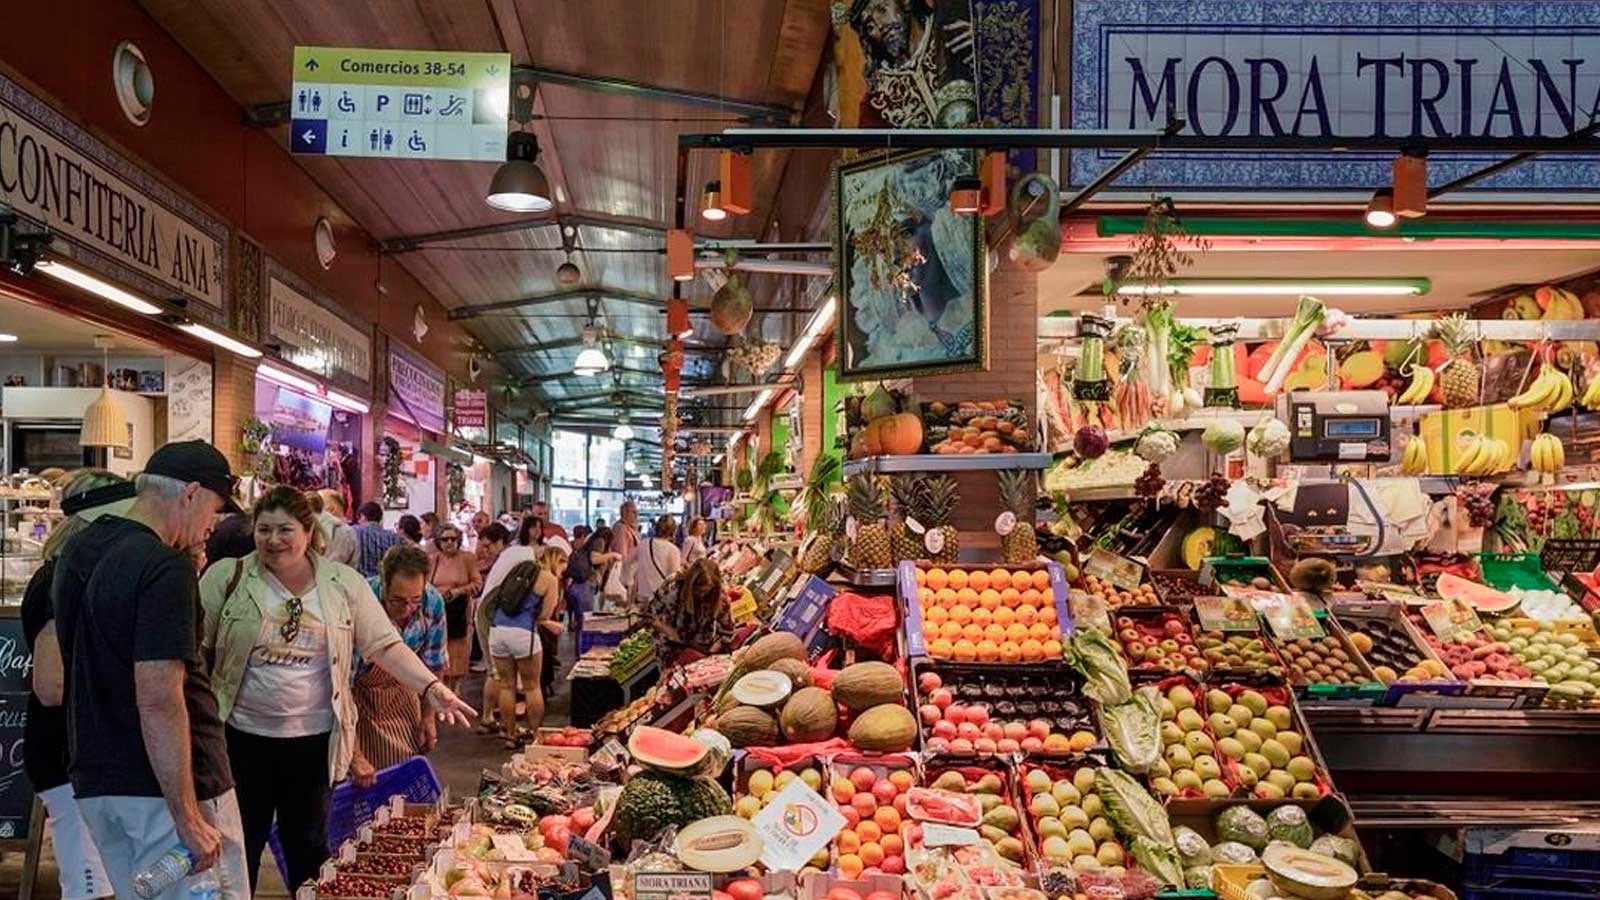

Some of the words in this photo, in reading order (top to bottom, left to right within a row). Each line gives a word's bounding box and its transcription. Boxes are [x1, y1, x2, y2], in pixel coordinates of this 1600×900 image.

[340, 58, 420, 76] Comercios
[424, 62, 466, 76] 38-54
[376, 95, 389, 112] P
[1125, 54, 1333, 139] MORA
[0, 121, 161, 271] CONFITERIA
[171, 228, 210, 296] ANA
[671, 877, 707, 888] TRIANA
